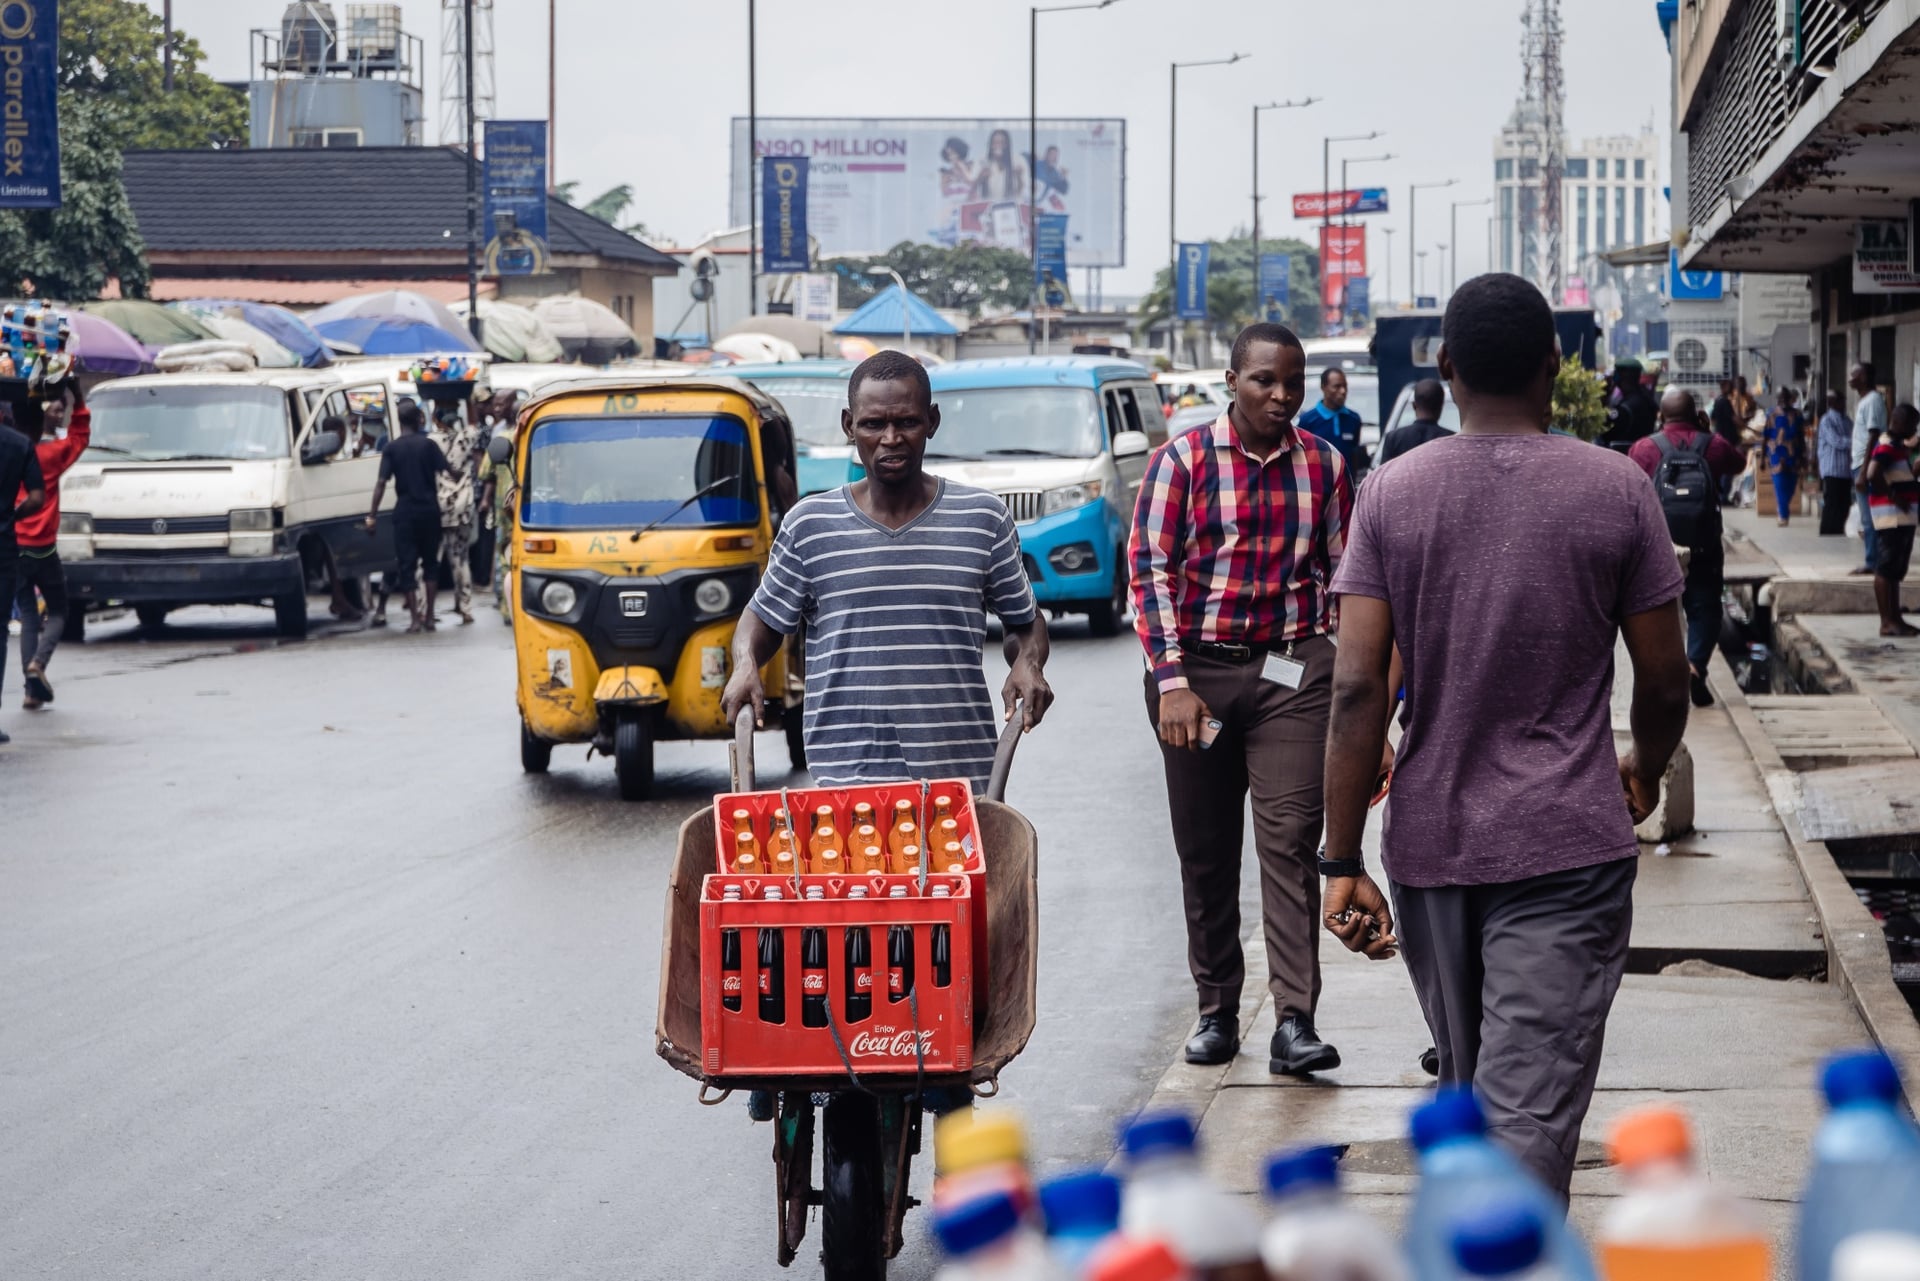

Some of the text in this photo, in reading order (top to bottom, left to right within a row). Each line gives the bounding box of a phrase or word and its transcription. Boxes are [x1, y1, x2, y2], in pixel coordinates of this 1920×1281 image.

[1, 46, 28, 177] parallex
[813, 139, 907, 156] MILLION
[1, 185, 48, 196] Limitless
[778, 189, 793, 257] parallex
[588, 536, 619, 553] A2
[625, 600, 643, 611] RE
[874, 1025, 896, 1034] Enjoy
[849, 1029, 936, 1057] Coca-Cola
